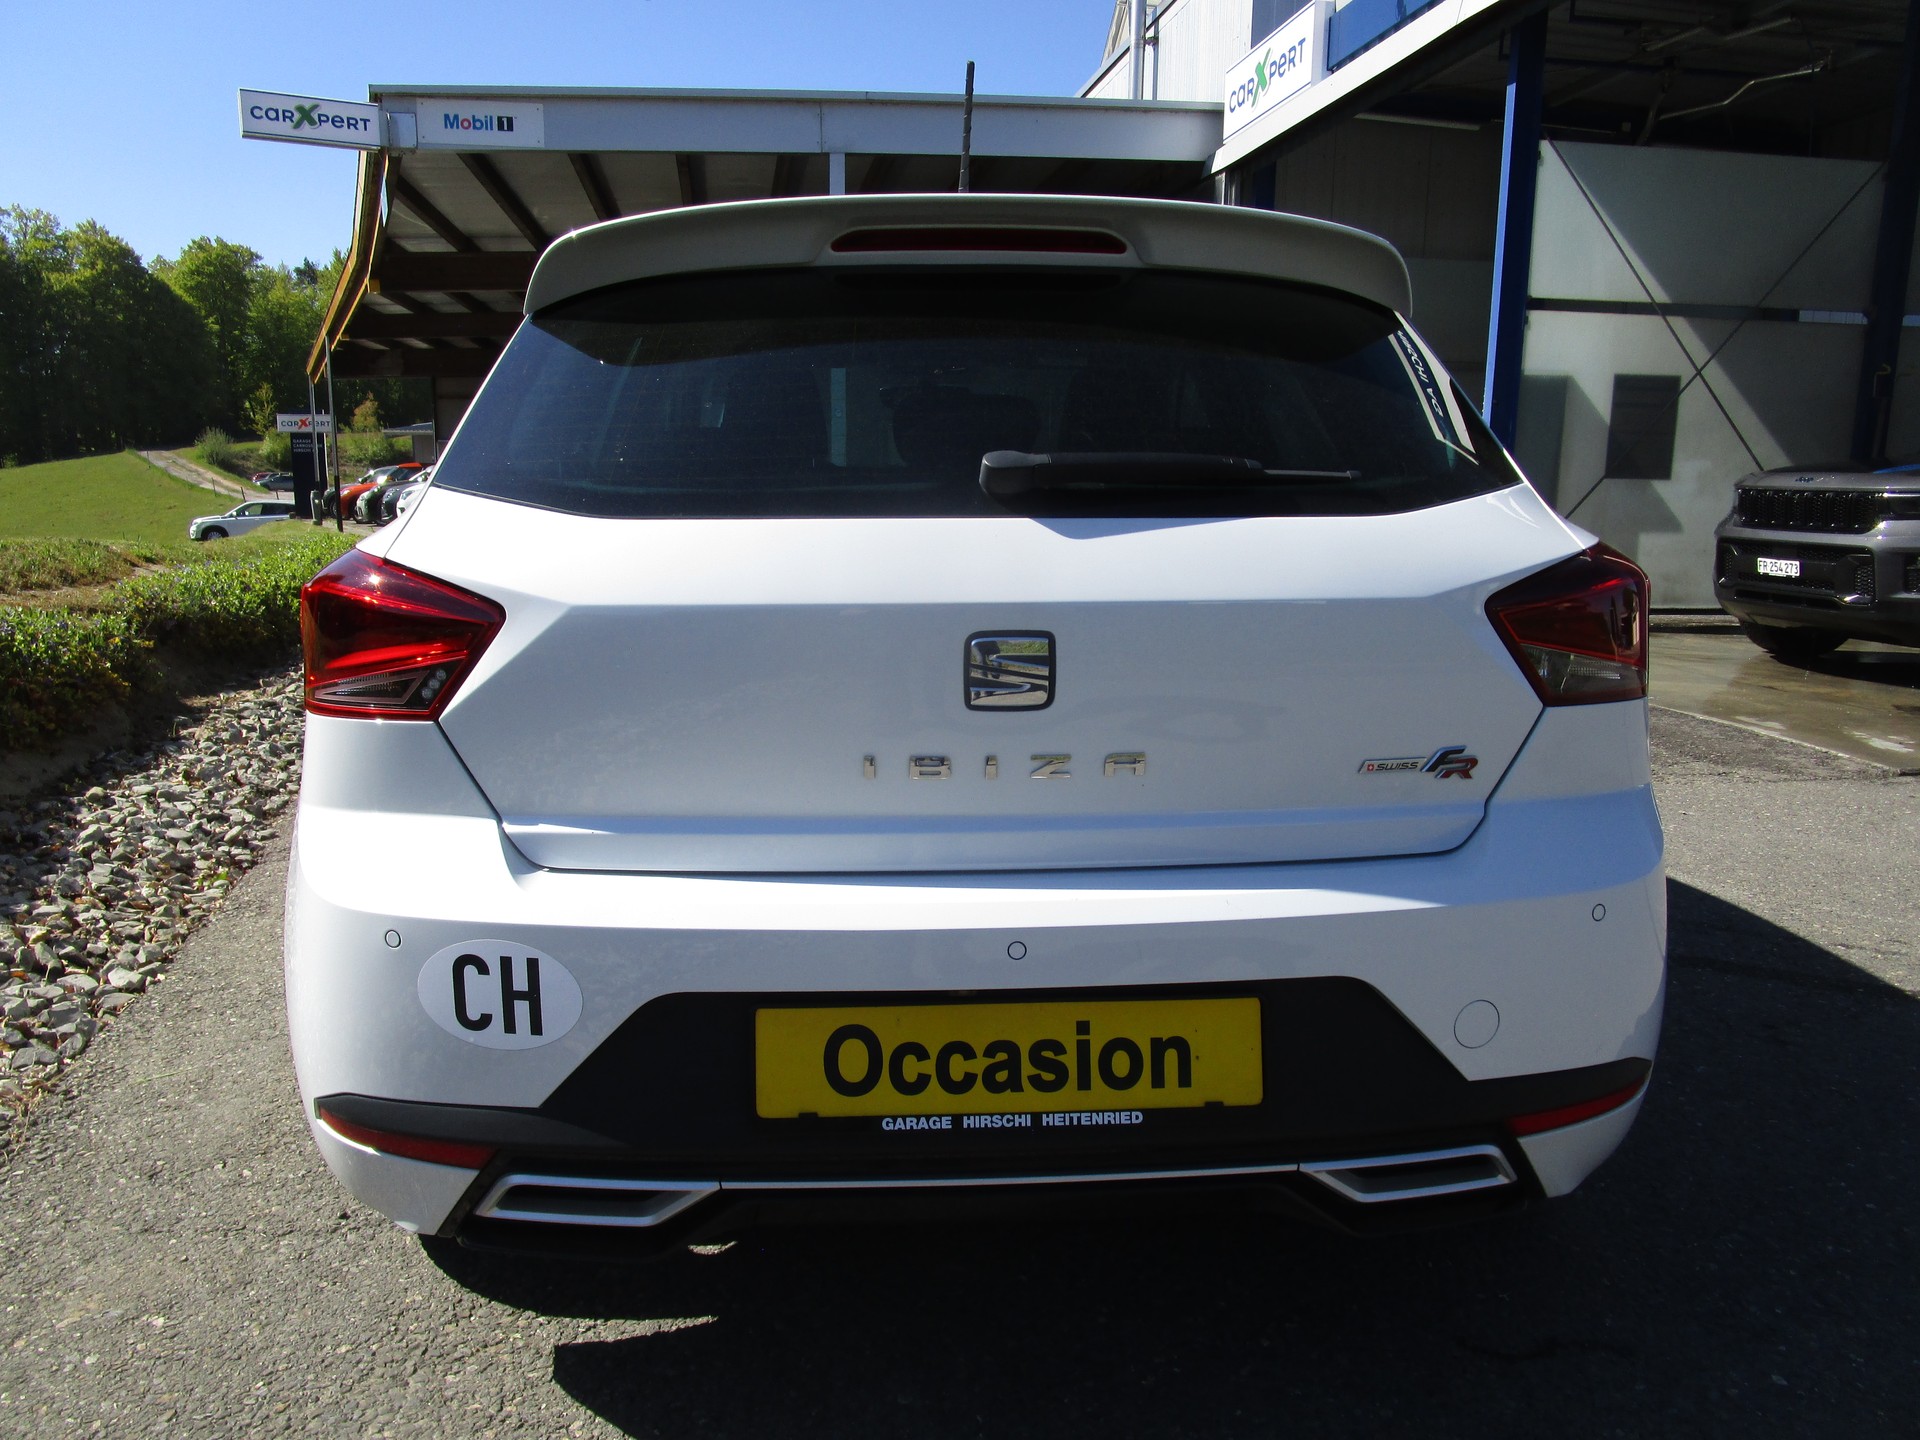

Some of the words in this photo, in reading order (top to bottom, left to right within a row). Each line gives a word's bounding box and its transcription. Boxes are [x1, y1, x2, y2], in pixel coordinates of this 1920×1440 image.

[444, 113, 494, 131] Mobil
[863, 752, 1147, 781] IBIZA
[1375, 761, 1419, 771] SWISS
[1420, 745, 1478, 779] FR
[452, 953, 543, 1036] CH
[822, 1020, 1193, 1098] Occasion
[881, 1115, 953, 1131] GARAGE
[962, 1113, 1032, 1129] HIRSCHI
[1042, 1111, 1144, 1127] HEITENRIED
